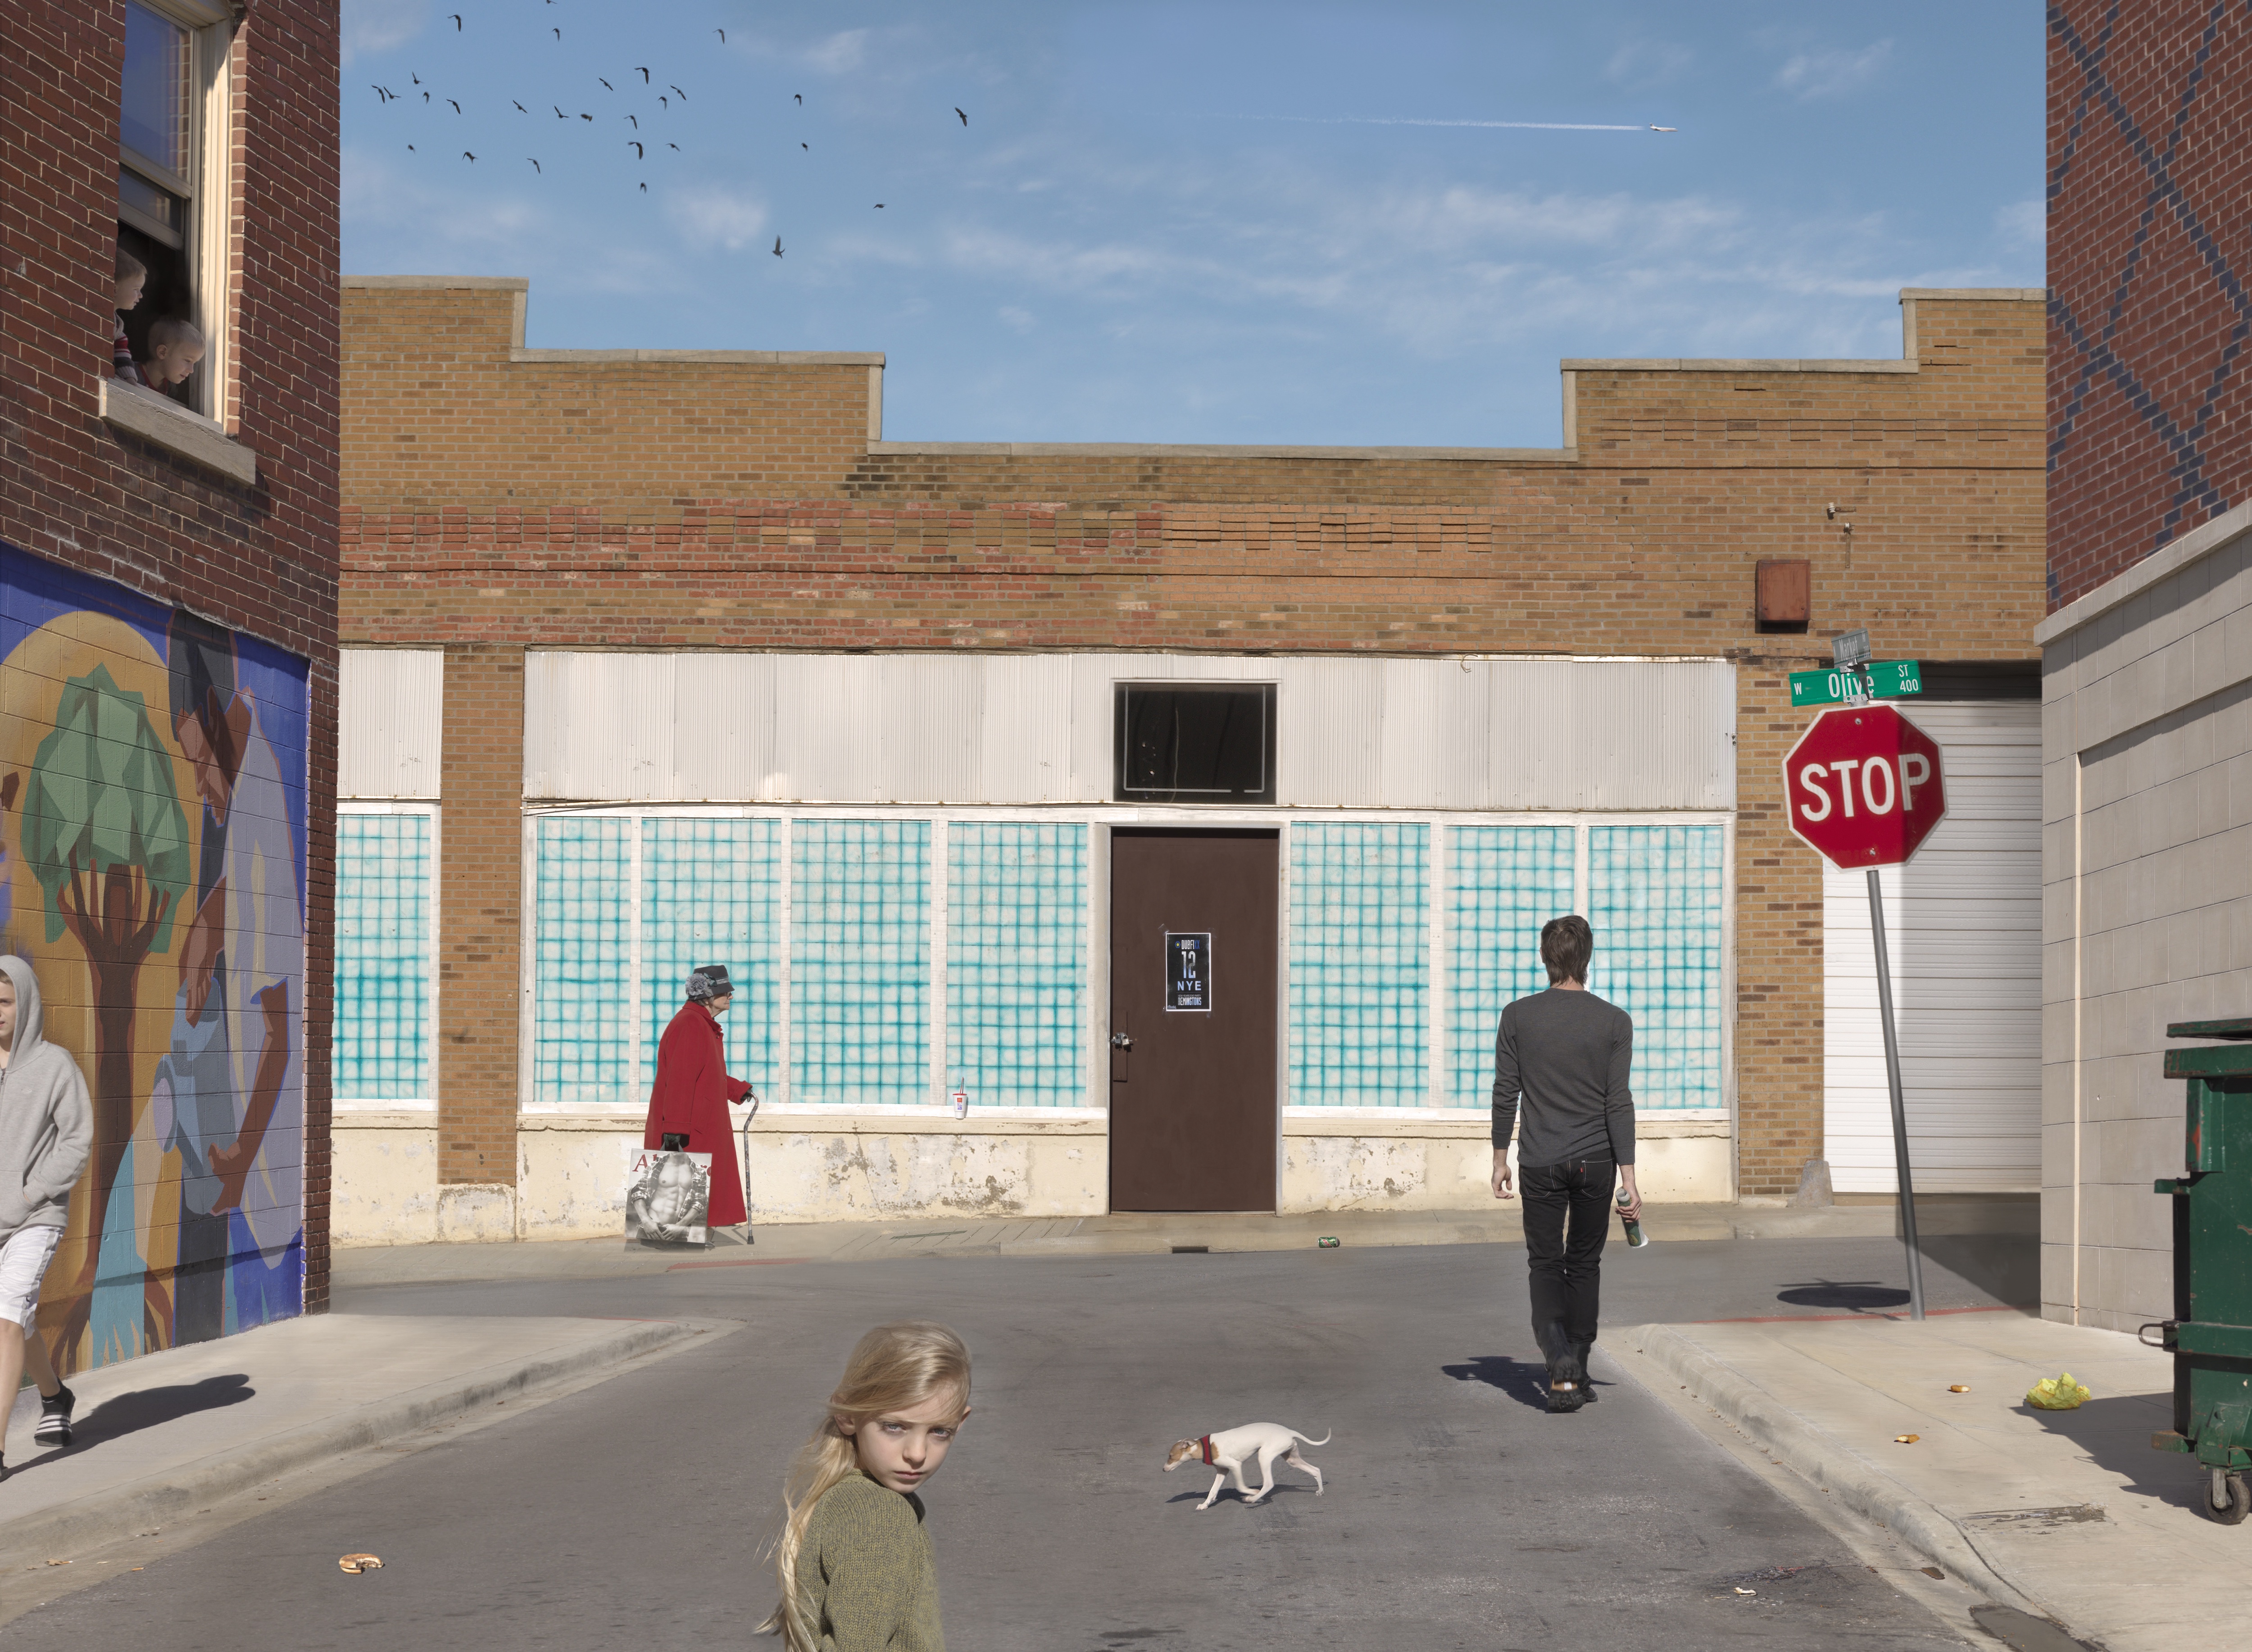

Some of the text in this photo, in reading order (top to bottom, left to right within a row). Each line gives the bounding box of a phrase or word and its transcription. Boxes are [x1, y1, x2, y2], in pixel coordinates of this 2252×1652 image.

[1839, 635, 1859, 661] Market
[1793, 664, 1908, 698] W Olive ST
[1899, 678, 1919, 693] 400
[1800, 753, 1931, 822] STOP
[1181, 939, 1200, 949] DUBFIXX
[1181, 951, 1196, 979] 12
[1177, 980, 1202, 991] NYE
[1178, 997, 1202, 1006] REMINGTONS
